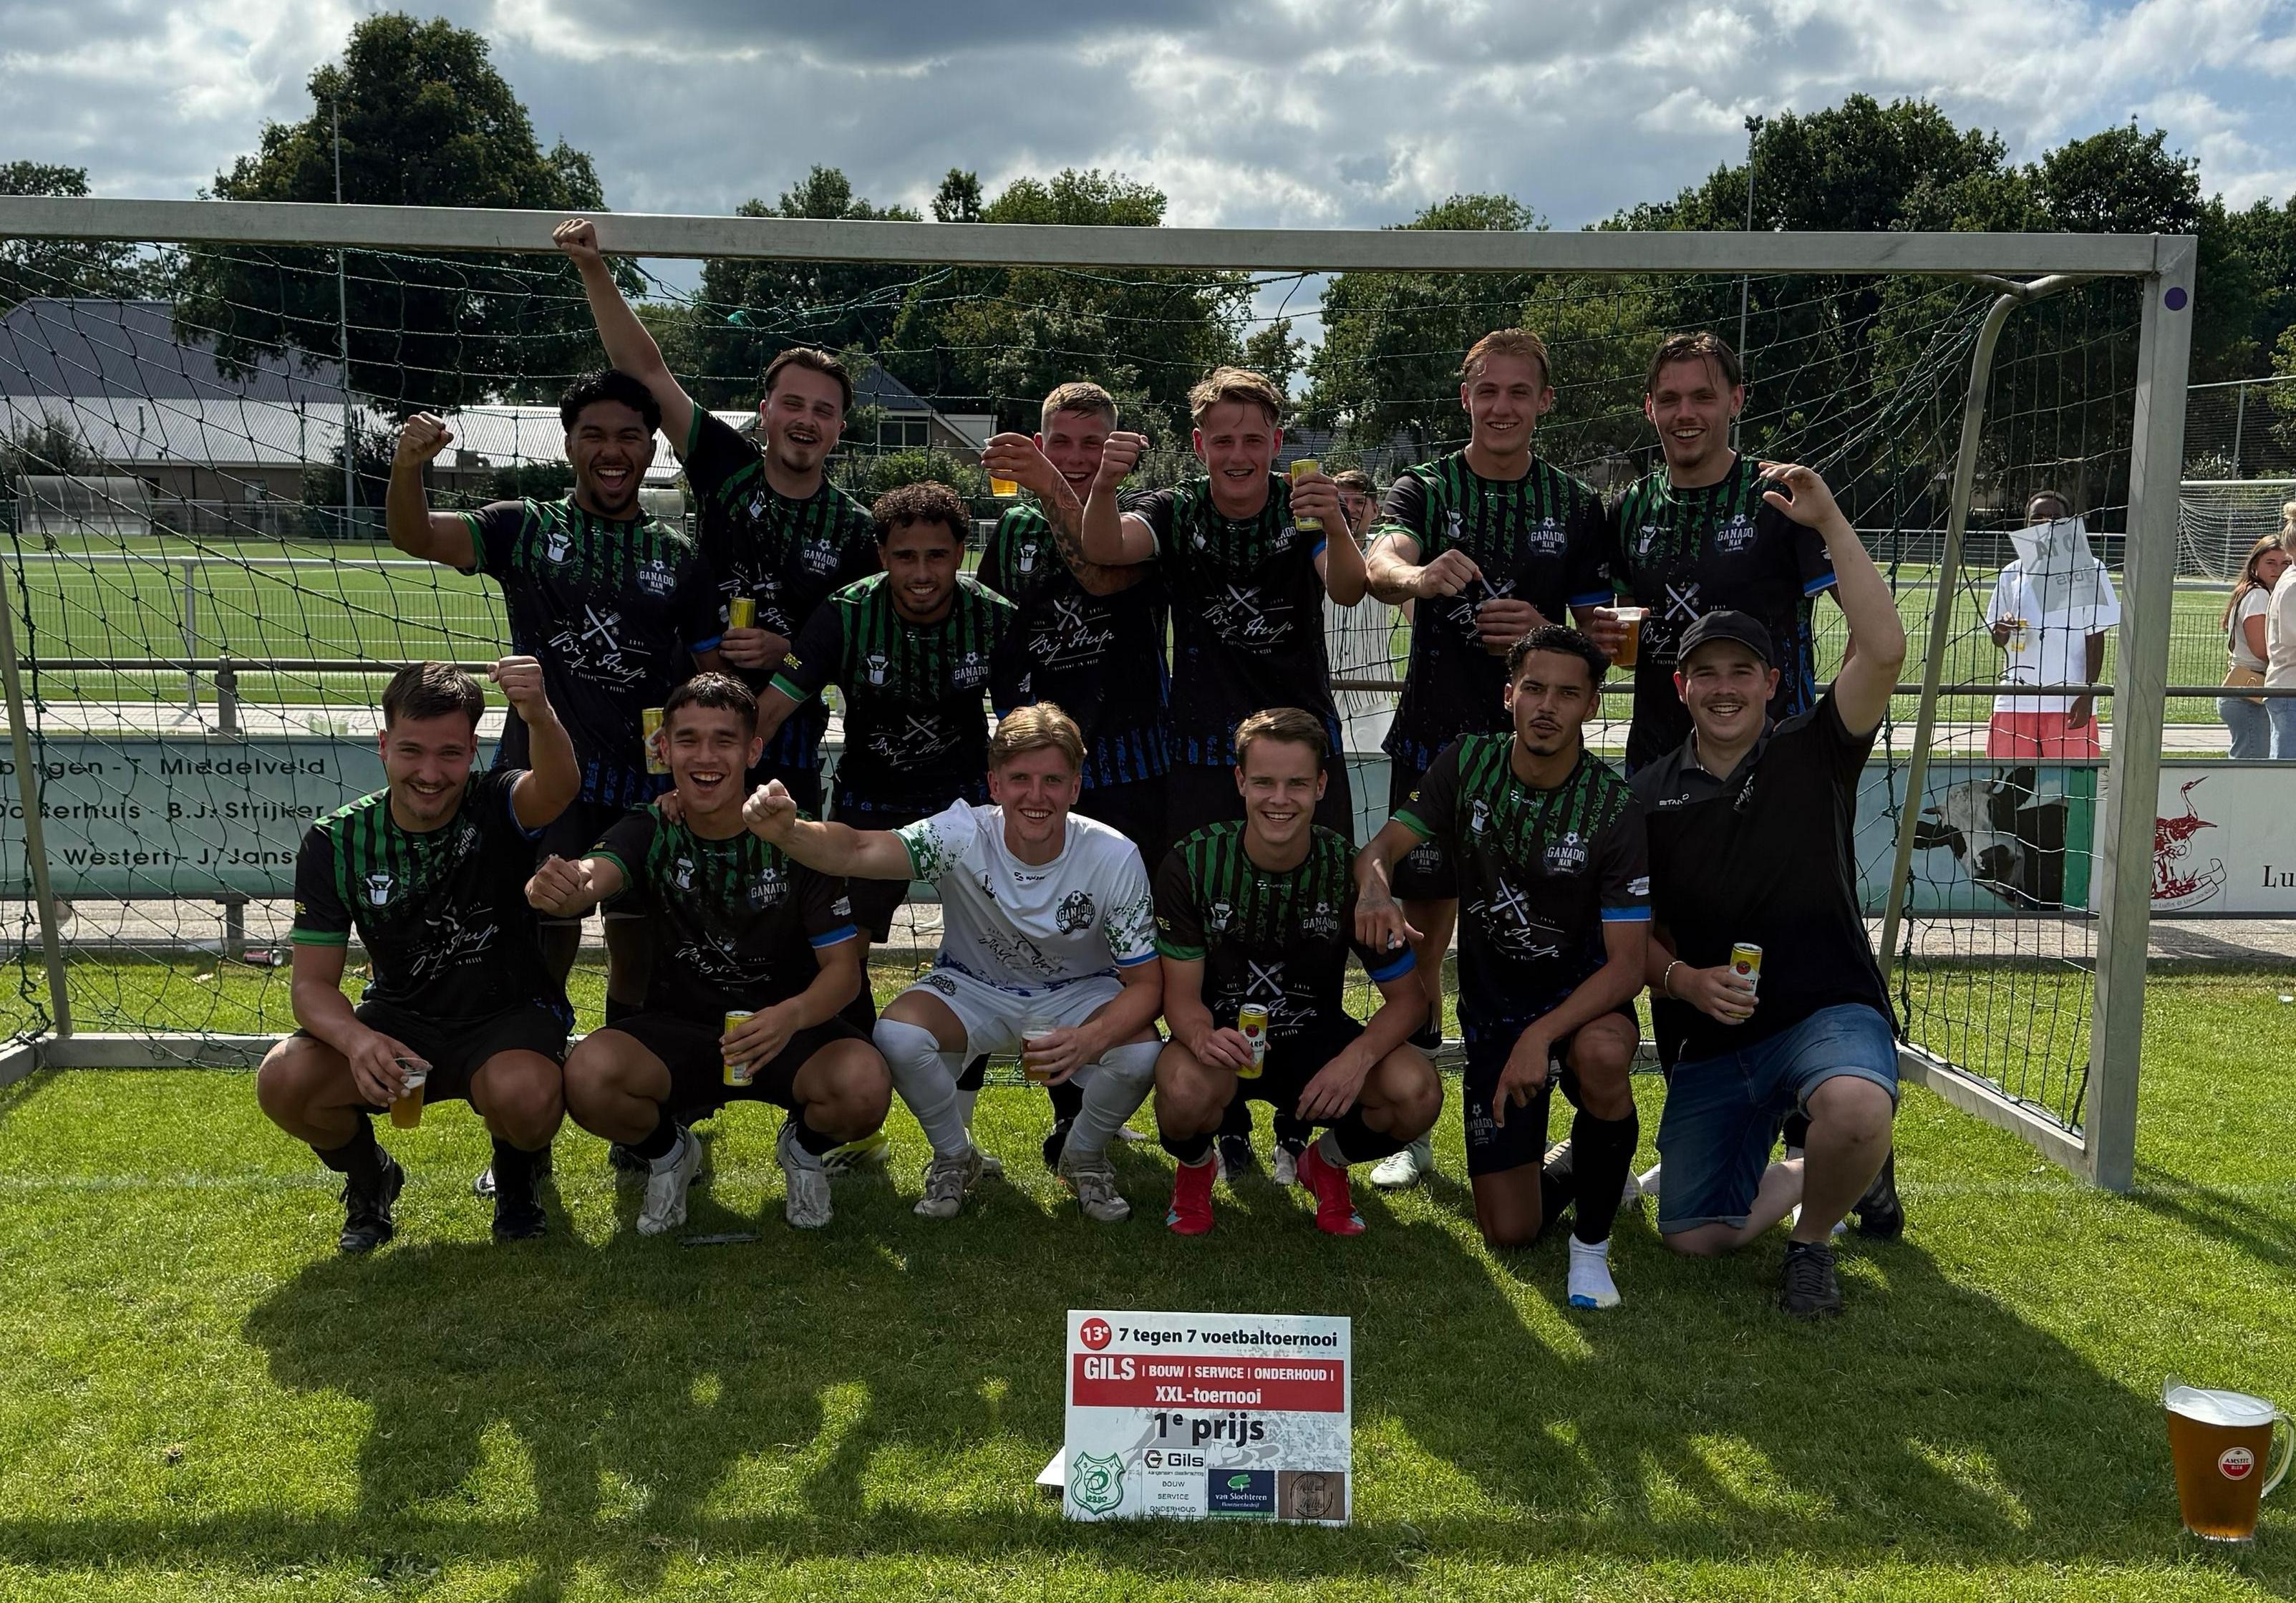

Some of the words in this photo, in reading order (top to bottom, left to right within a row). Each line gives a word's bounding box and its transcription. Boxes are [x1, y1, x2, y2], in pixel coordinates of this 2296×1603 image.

[1531, 532, 1565, 543] GANADO
[1718, 527, 1753, 541] GANADO
[804, 549, 837, 568] GANADO
[640, 571, 674, 587] GANADO
[160, 758, 325, 775] Middelveld
[226, 802, 324, 822] Strijker
[1547, 846, 1584, 863] GANADO
[1119, 1328, 1129, 1341] 7
[1133, 1329, 1182, 1346] tegen
[1187, 1330, 1197, 1343] 7
[1201, 1330, 1337, 1347] voetbaltoernooi
[1084, 1357, 1136, 1380] GILS
[1148, 1365, 1183, 1377] BOUW
[1194, 1366, 1244, 1379] SERVICE
[1254, 1367, 1327, 1381] ONDERHOUD
[1155, 1385, 1261, 1404] XXL-toernooi
[1154, 1412, 1183, 1438] 1e
[1192, 1412, 1264, 1448] prijs
[1168, 1453, 1204, 1468] Gils
[1230, 1491, 1267, 1501] Slochteren
